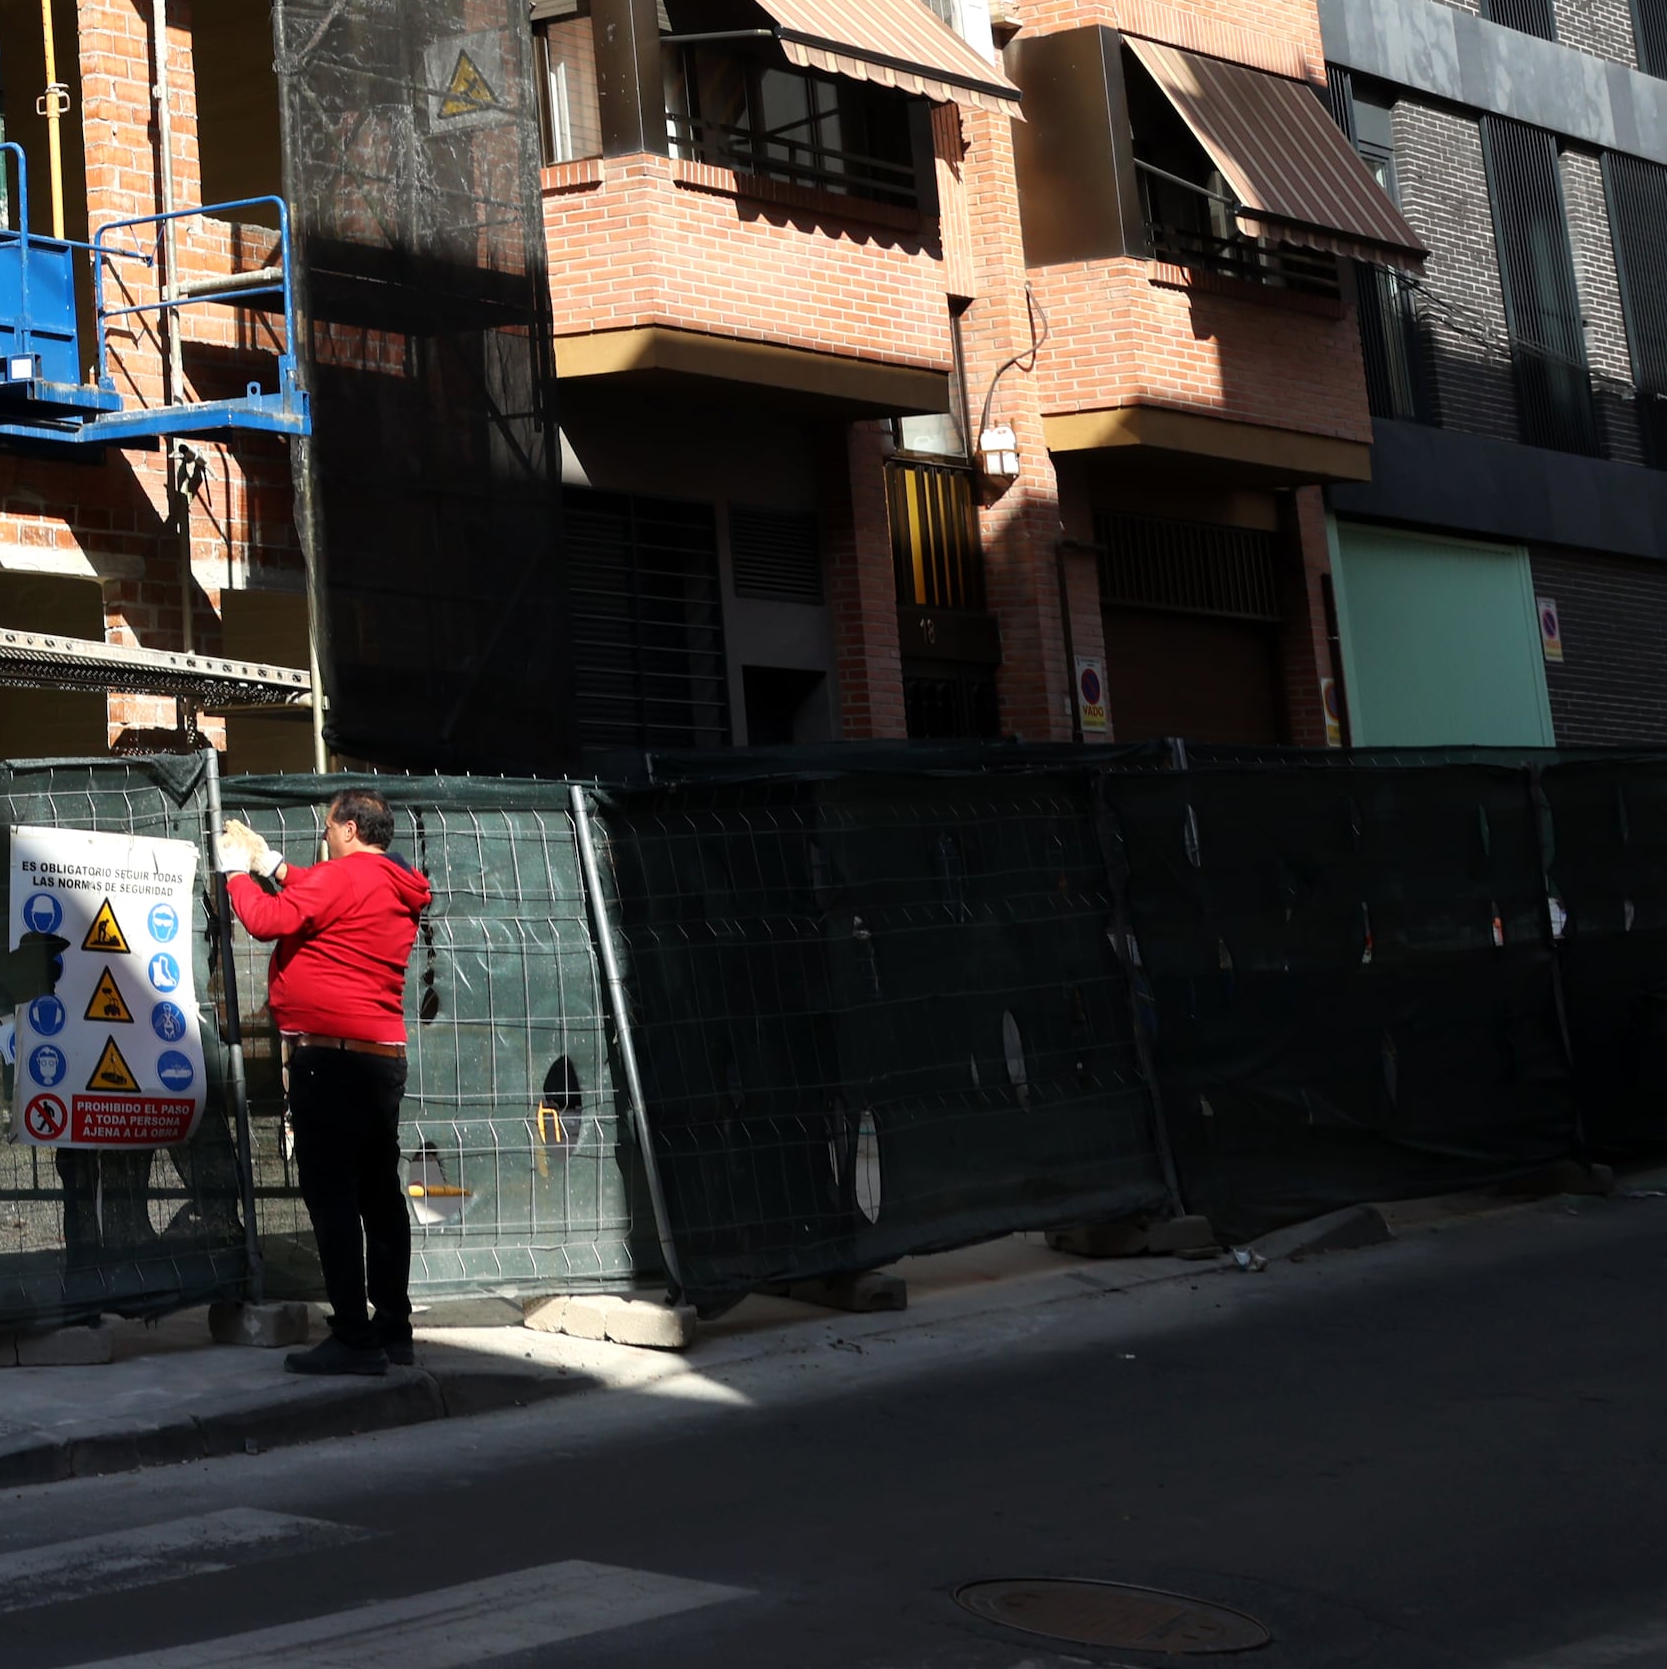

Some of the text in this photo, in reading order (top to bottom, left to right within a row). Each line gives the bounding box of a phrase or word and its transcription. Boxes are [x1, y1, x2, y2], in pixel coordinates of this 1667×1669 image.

[1082, 705, 1104, 717] VADO
[22, 860, 184, 884] ES OBLIGATORIO SEGUIR TODAS
[33, 875, 55, 888] LAS
[105, 882, 117, 893] DE
[119, 882, 174, 897] SEGURIDAD
[77, 1101, 190, 1115] PROHIBIDO EL PASO
[84, 1114, 180, 1127] A TODA PERSONA
[82, 1127, 179, 1138] AJENA A LA OBRA
